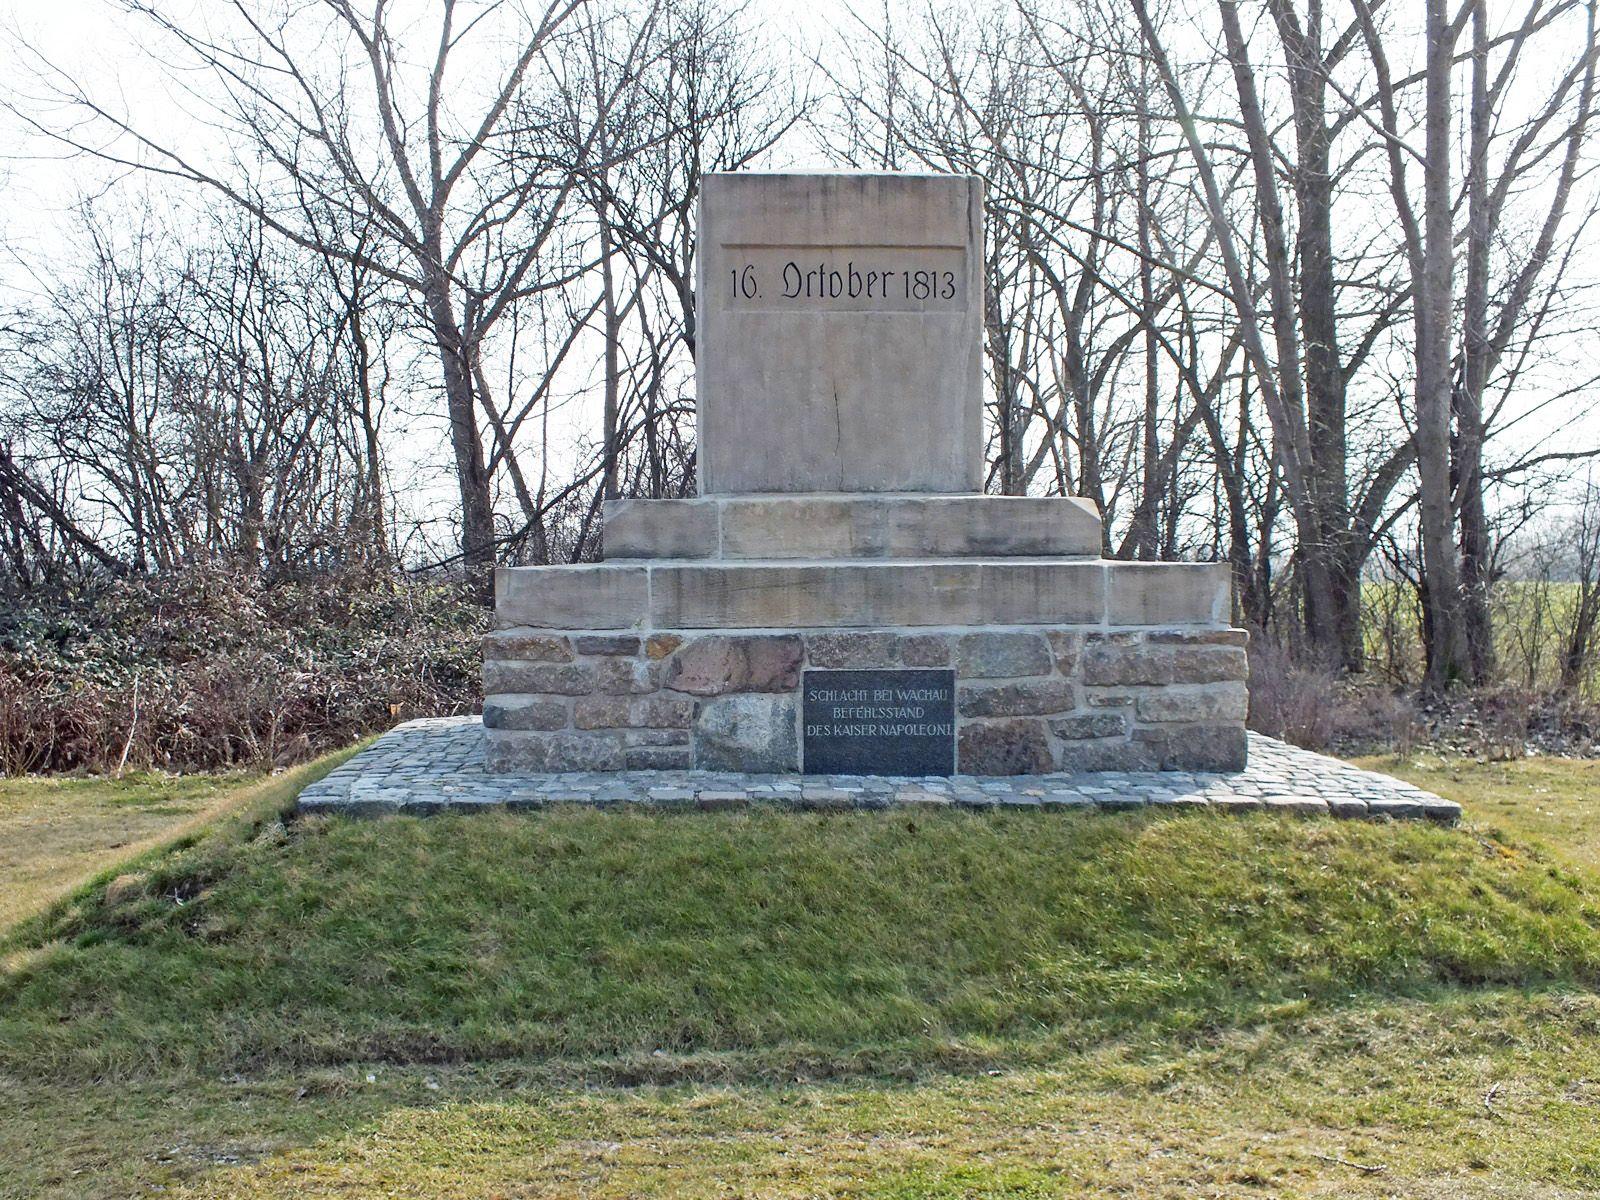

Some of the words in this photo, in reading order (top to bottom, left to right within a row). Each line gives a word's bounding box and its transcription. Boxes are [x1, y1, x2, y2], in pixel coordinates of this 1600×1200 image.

[731, 264, 763, 299] 16.
[782, 261, 895, 299] October
[903, 270, 956, 300] 1813
[810, 689, 868, 702] SCHLACHT
[873, 689, 893, 701] BEI
[897, 689, 948, 701] WACHAU
[833, 706, 925, 719] BEFEHLSSTAND
[807, 724, 831, 736] DES
[834, 724, 877, 736] KAISER
